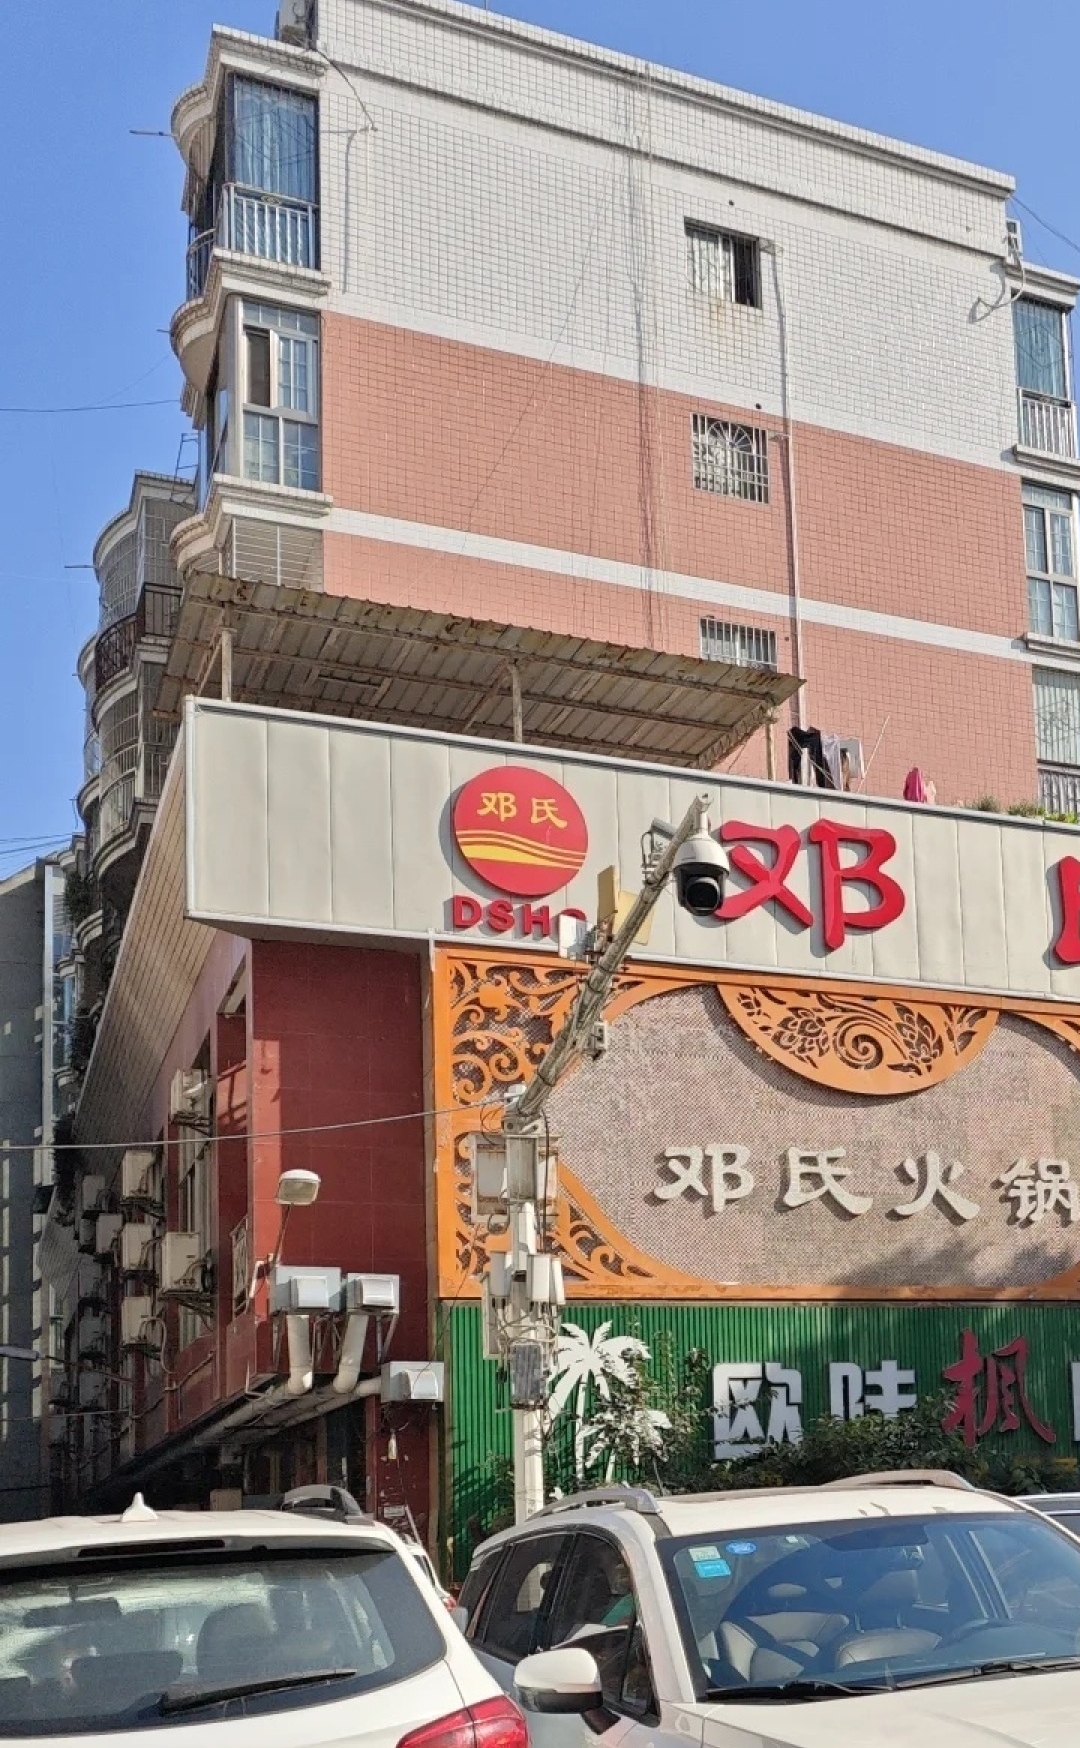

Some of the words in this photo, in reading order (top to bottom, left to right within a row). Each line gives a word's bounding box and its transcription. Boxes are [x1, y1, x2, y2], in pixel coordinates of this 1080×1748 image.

[477, 790, 568, 829] 邓氏
[655, 1143, 1080, 1222] 邓氏火锅
